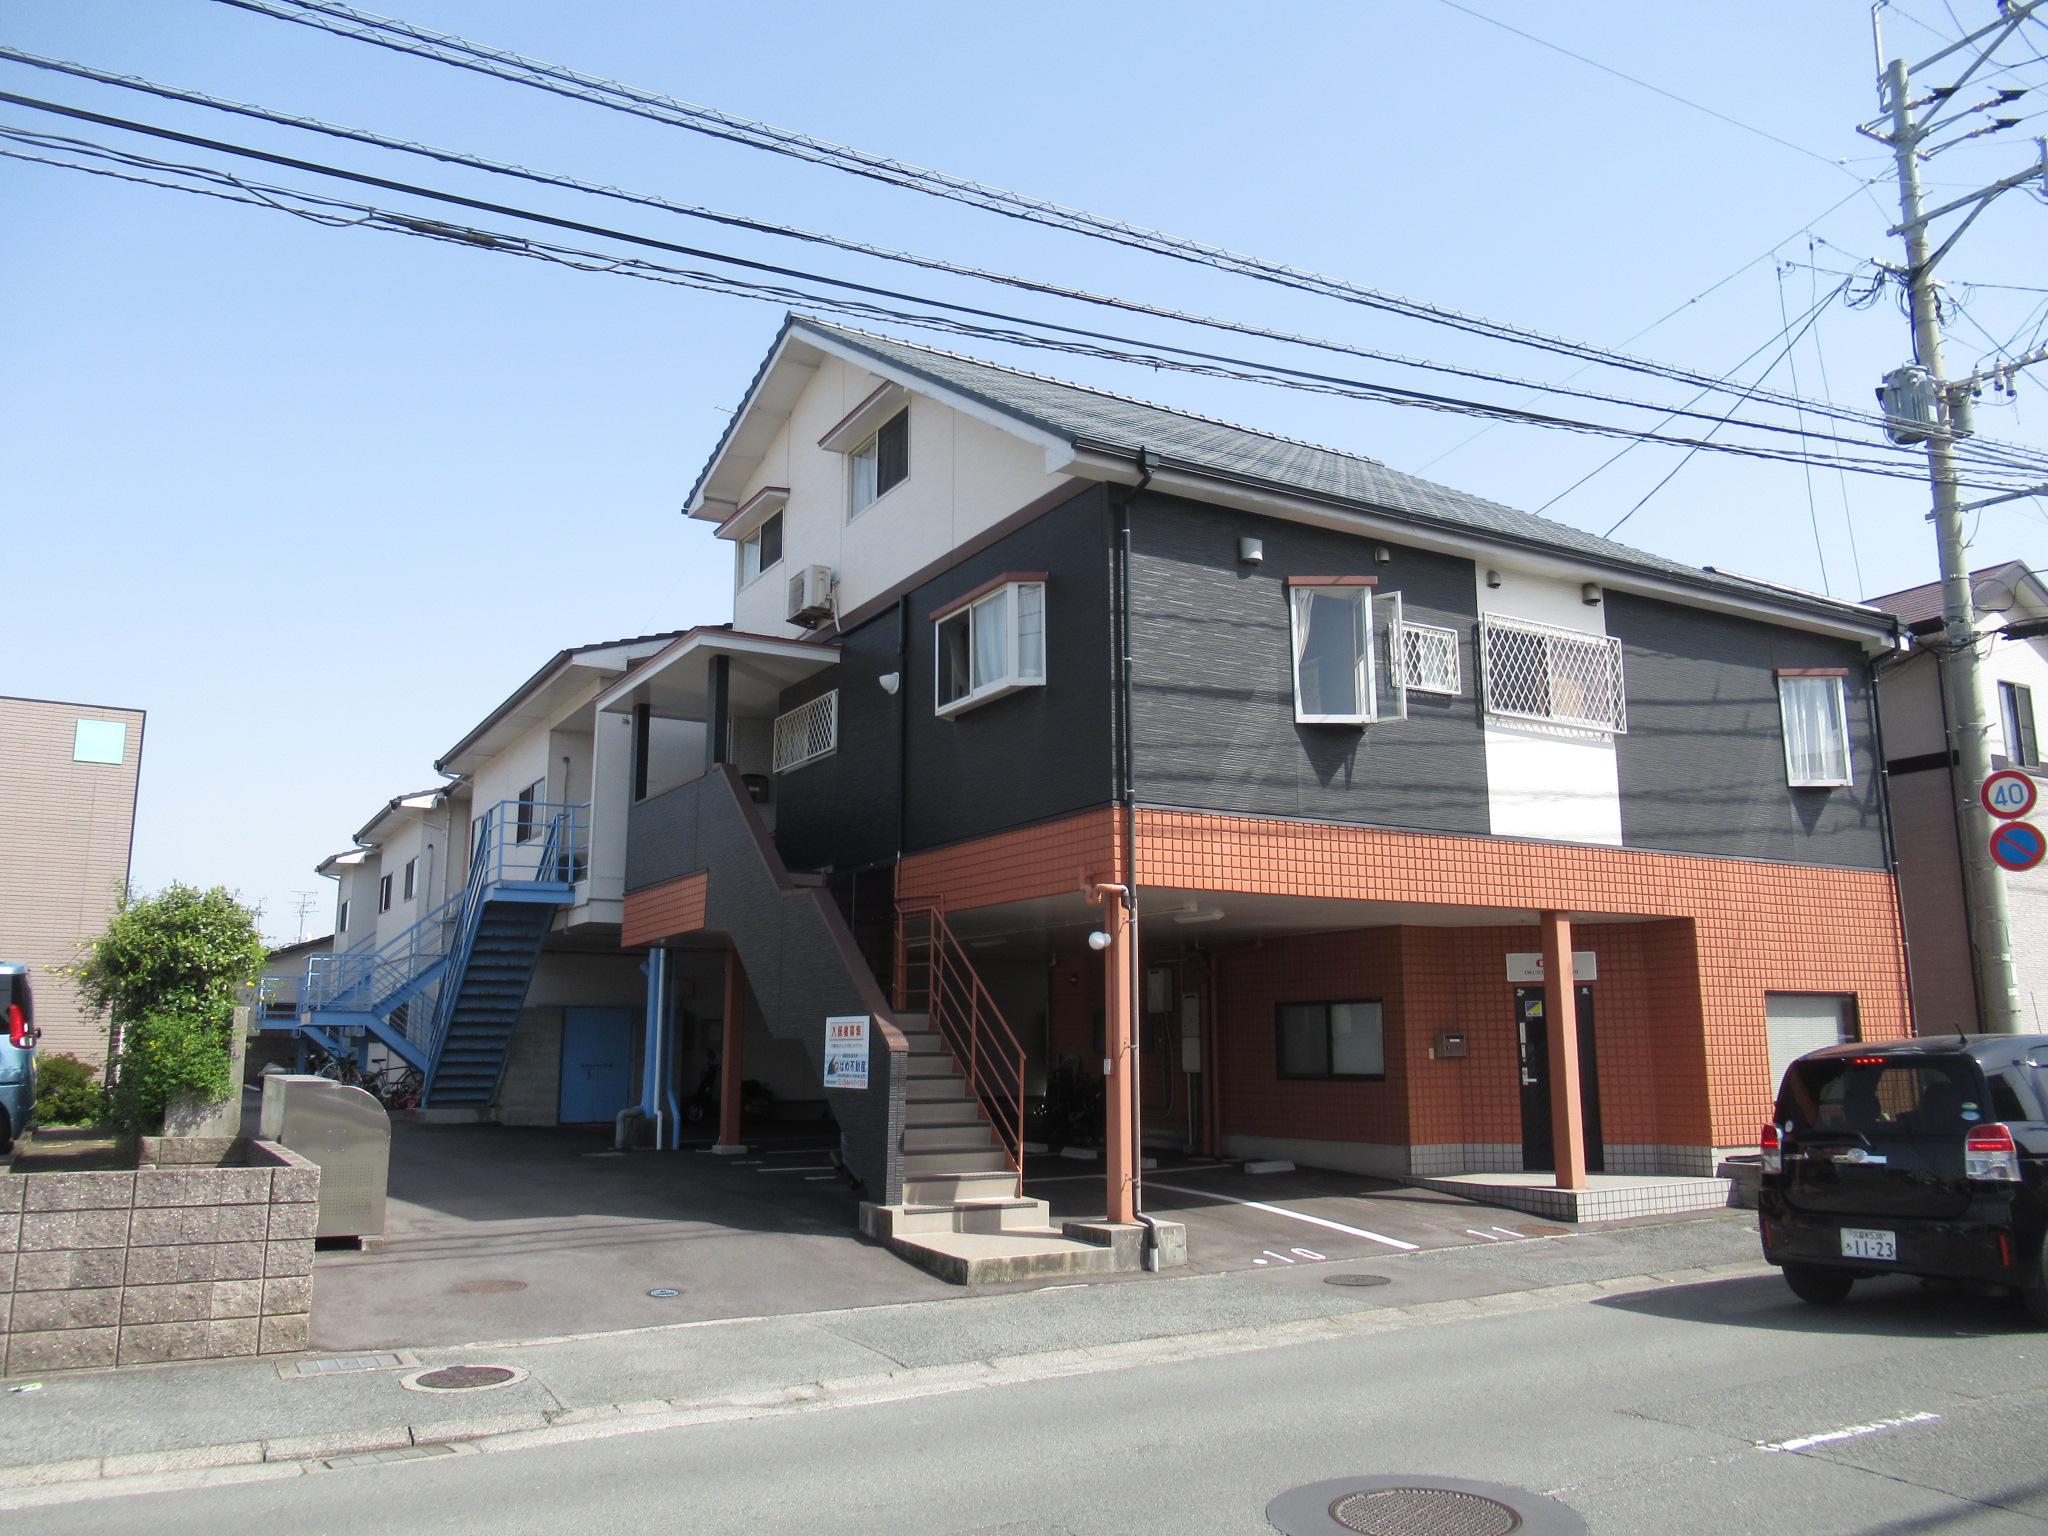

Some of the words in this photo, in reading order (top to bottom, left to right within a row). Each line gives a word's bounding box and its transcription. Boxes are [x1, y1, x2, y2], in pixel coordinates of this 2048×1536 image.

[1994, 783, 2024, 806] 40
[832, 1025, 863, 1037] 入居者募集
[834, 1060, 866, 1073] つばめ不動産
[1855, 1240, 1893, 1257] 11-23
